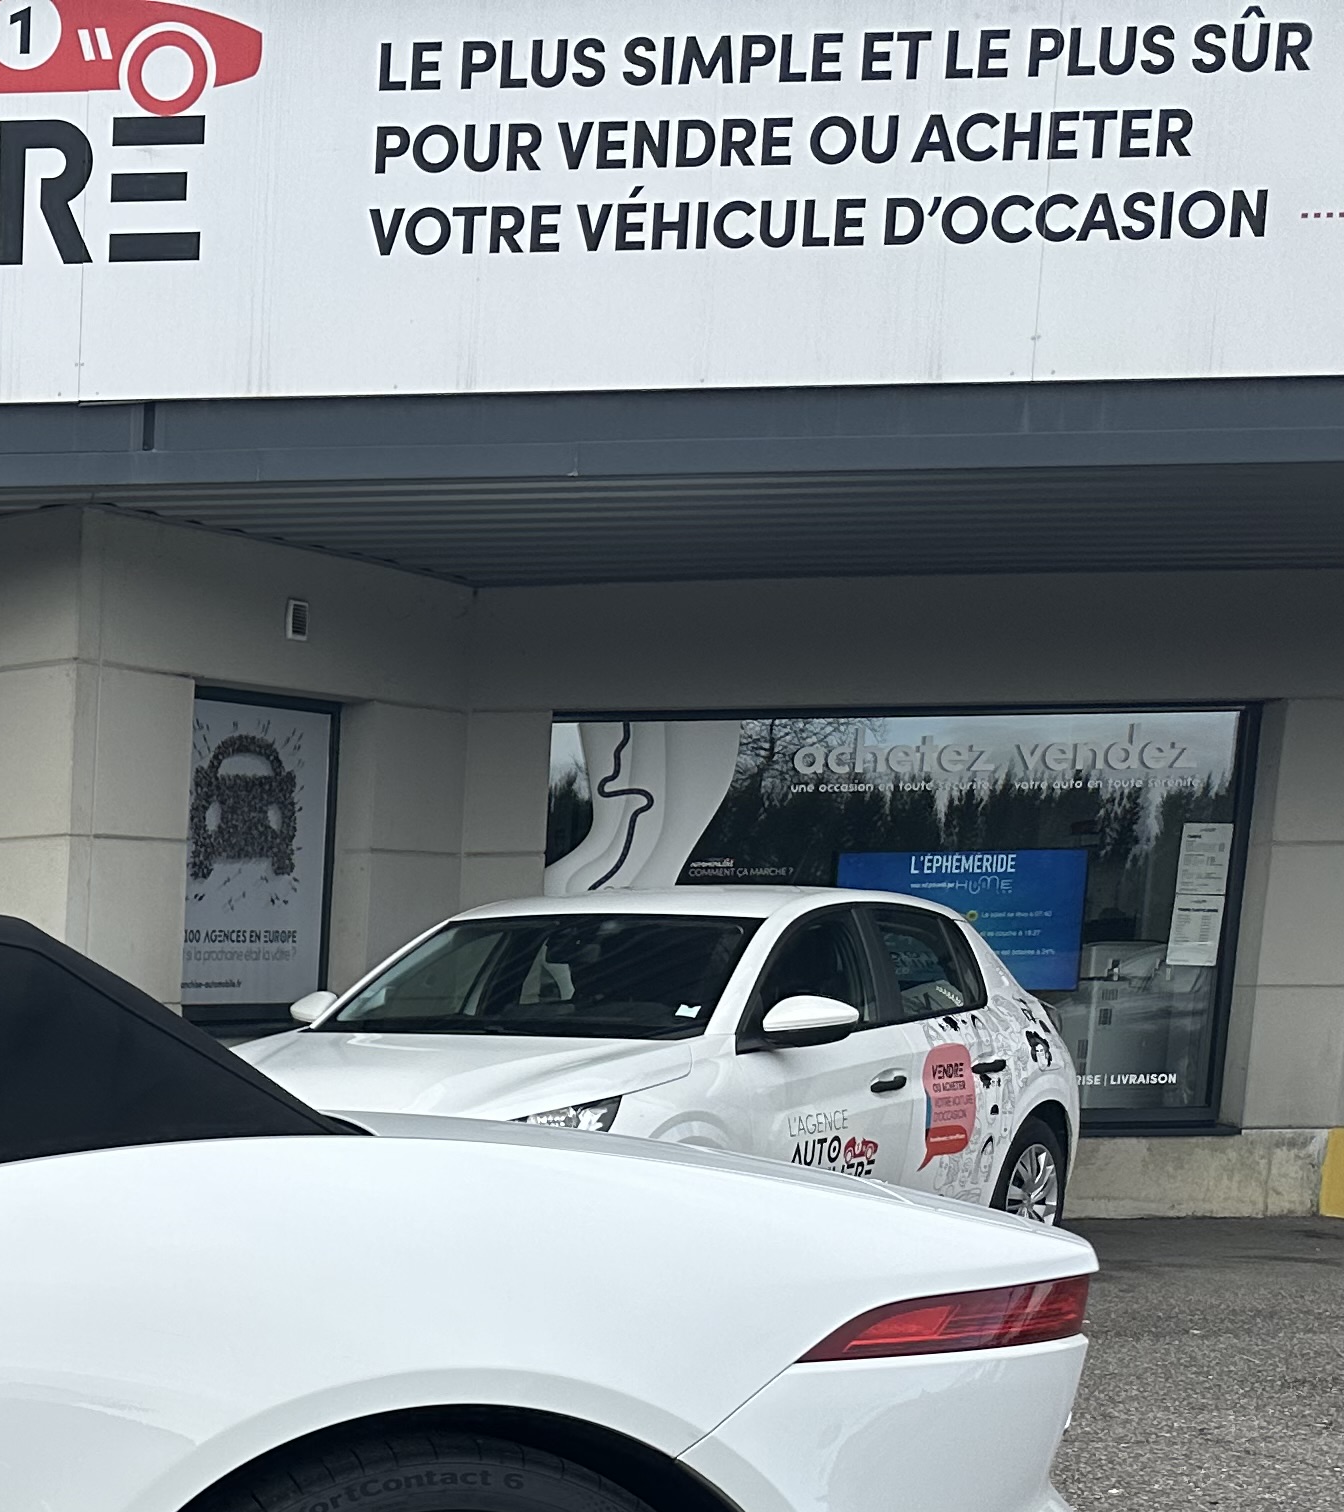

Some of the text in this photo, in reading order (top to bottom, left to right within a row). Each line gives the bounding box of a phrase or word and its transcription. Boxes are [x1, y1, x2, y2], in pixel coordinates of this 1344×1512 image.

[378, 5, 1313, 92] LE PLUS SIMPLE ET LE PLUS SÛR
[374, 108, 1194, 174] POUR VENDRE OU ACHETER
[369, 185, 1269, 256] VOTRE VÉHICULE D'OCCASION
[792, 722, 1198, 775] achetez vendez
[790, 782, 815, 793] une
[818, 780, 874, 793] occasion
[1053, 778, 1083, 790] auto
[688, 867, 735, 877] COMMENT
[749, 866, 786, 877] MARCHE
[910, 852, 1017, 874] L'ÉPHÉMÉRIDE
[202, 929, 247, 944] AGENCES
[249, 929, 262, 943] EN
[263, 929, 297, 943] EUROPE
[931, 1062, 965, 1080] VENDRE
[1109, 1073, 1177, 1085] LIVRAISON
[787, 1108, 849, 1138] L'AGENCE
[791, 1134, 842, 1167] AUTO
[503, 1472, 525, 1491] 6
